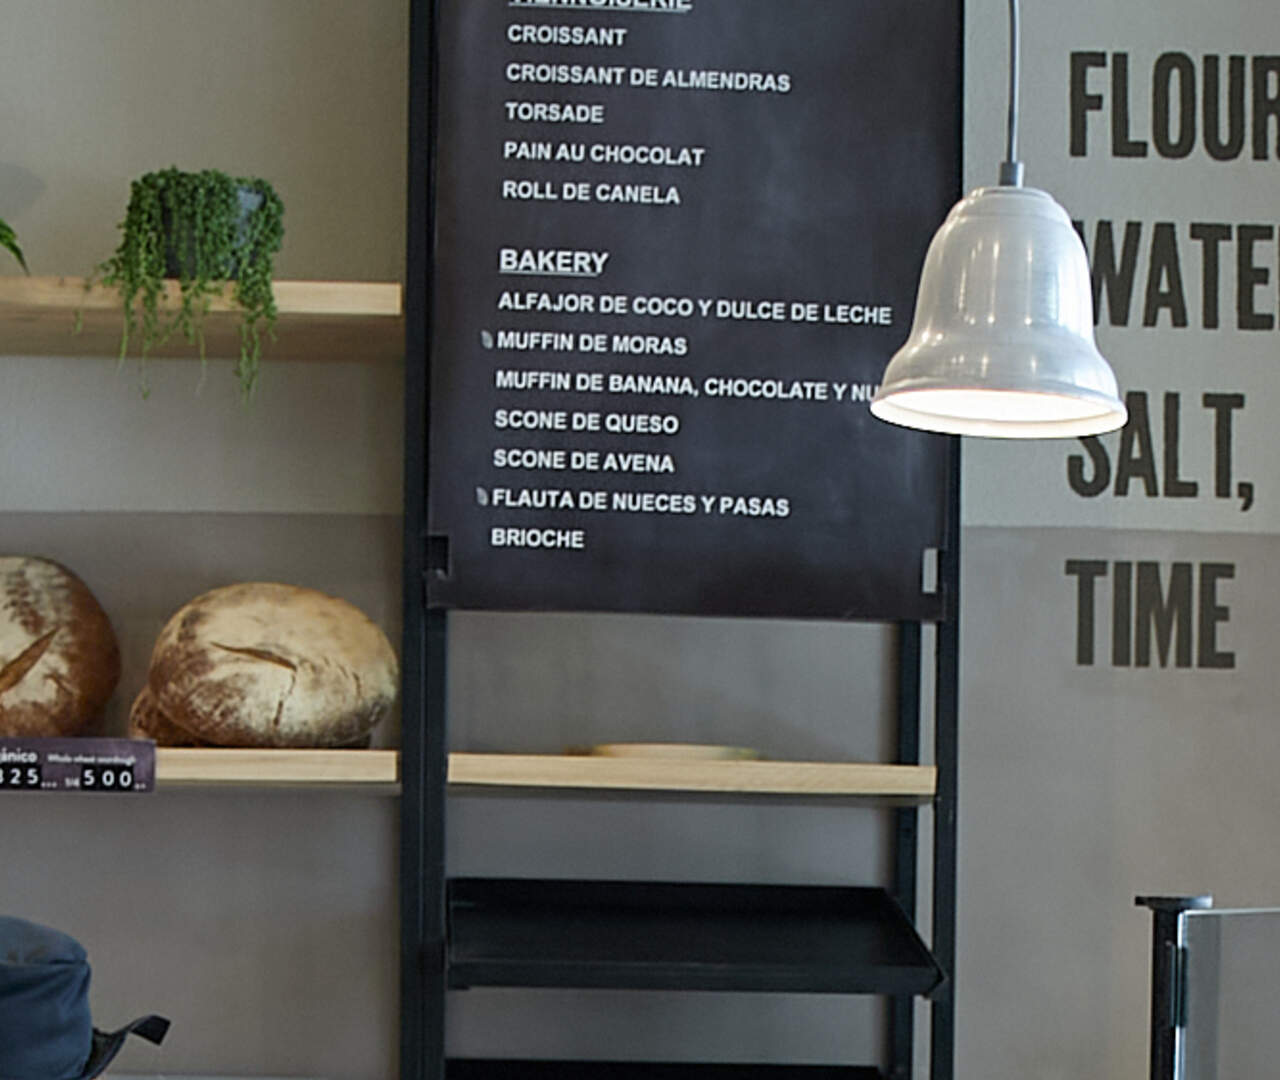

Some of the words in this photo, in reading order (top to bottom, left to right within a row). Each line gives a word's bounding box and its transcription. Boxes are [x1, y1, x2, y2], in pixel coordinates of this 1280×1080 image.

[507, 24, 627, 46] CROISSANT
[506, 63, 626, 85] CROISSANT
[630, 68, 658, 86] DE
[662, 69, 791, 92] ALMENDRAS
[505, 102, 604, 123] TORSADE
[504, 141, 552, 160] PAIN
[555, 143, 585, 161] AU
[590, 144, 705, 166] CHOCOLAT
[503, 180, 558, 199] ROLL
[562, 182, 591, 201] DE
[595, 183, 680, 204] CANELA
[499, 249, 609, 276] BAKERY
[498, 291, 595, 312] ALFAJOR
[599, 295, 628, 314] DE
[632, 296, 694, 317] COCO
[698, 299, 713, 317] Y
[716, 300, 785, 320] DULCE
[791, 303, 819, 322] DE
[824, 304, 892, 325] LECHE
[497, 331, 574, 351] MUFFIN
[579, 333, 607, 352] DE
[612, 335, 687, 355] MORAS
[496, 370, 571, 390] MUFFIN
[575, 373, 604, 391] DE
[609, 374, 699, 397] BANANA,
[704, 377, 828, 400] CHOCOLATE
[833, 383, 847, 401] Y
[851, 383, 880, 402] NU
[495, 409, 567, 430] SCONE
[572, 412, 601, 431] DE
[605, 413, 679, 434] QUESO
[493, 448, 566, 469] SCONE
[571, 451, 599, 470] DE
[603, 453, 675, 473] AVENA
[1066, 391, 1255, 511] SALT,
[492, 488, 574, 508] FLAUTA
[579, 491, 607, 510] DE
[612, 492, 696, 513] NUECES
[700, 495, 716, 513] Y
[719, 496, 790, 517] PASAS
[491, 527, 584, 548] BRIOCHE
[1065, 559, 1236, 669] TIME
[84, 769, 132, 787] 500
